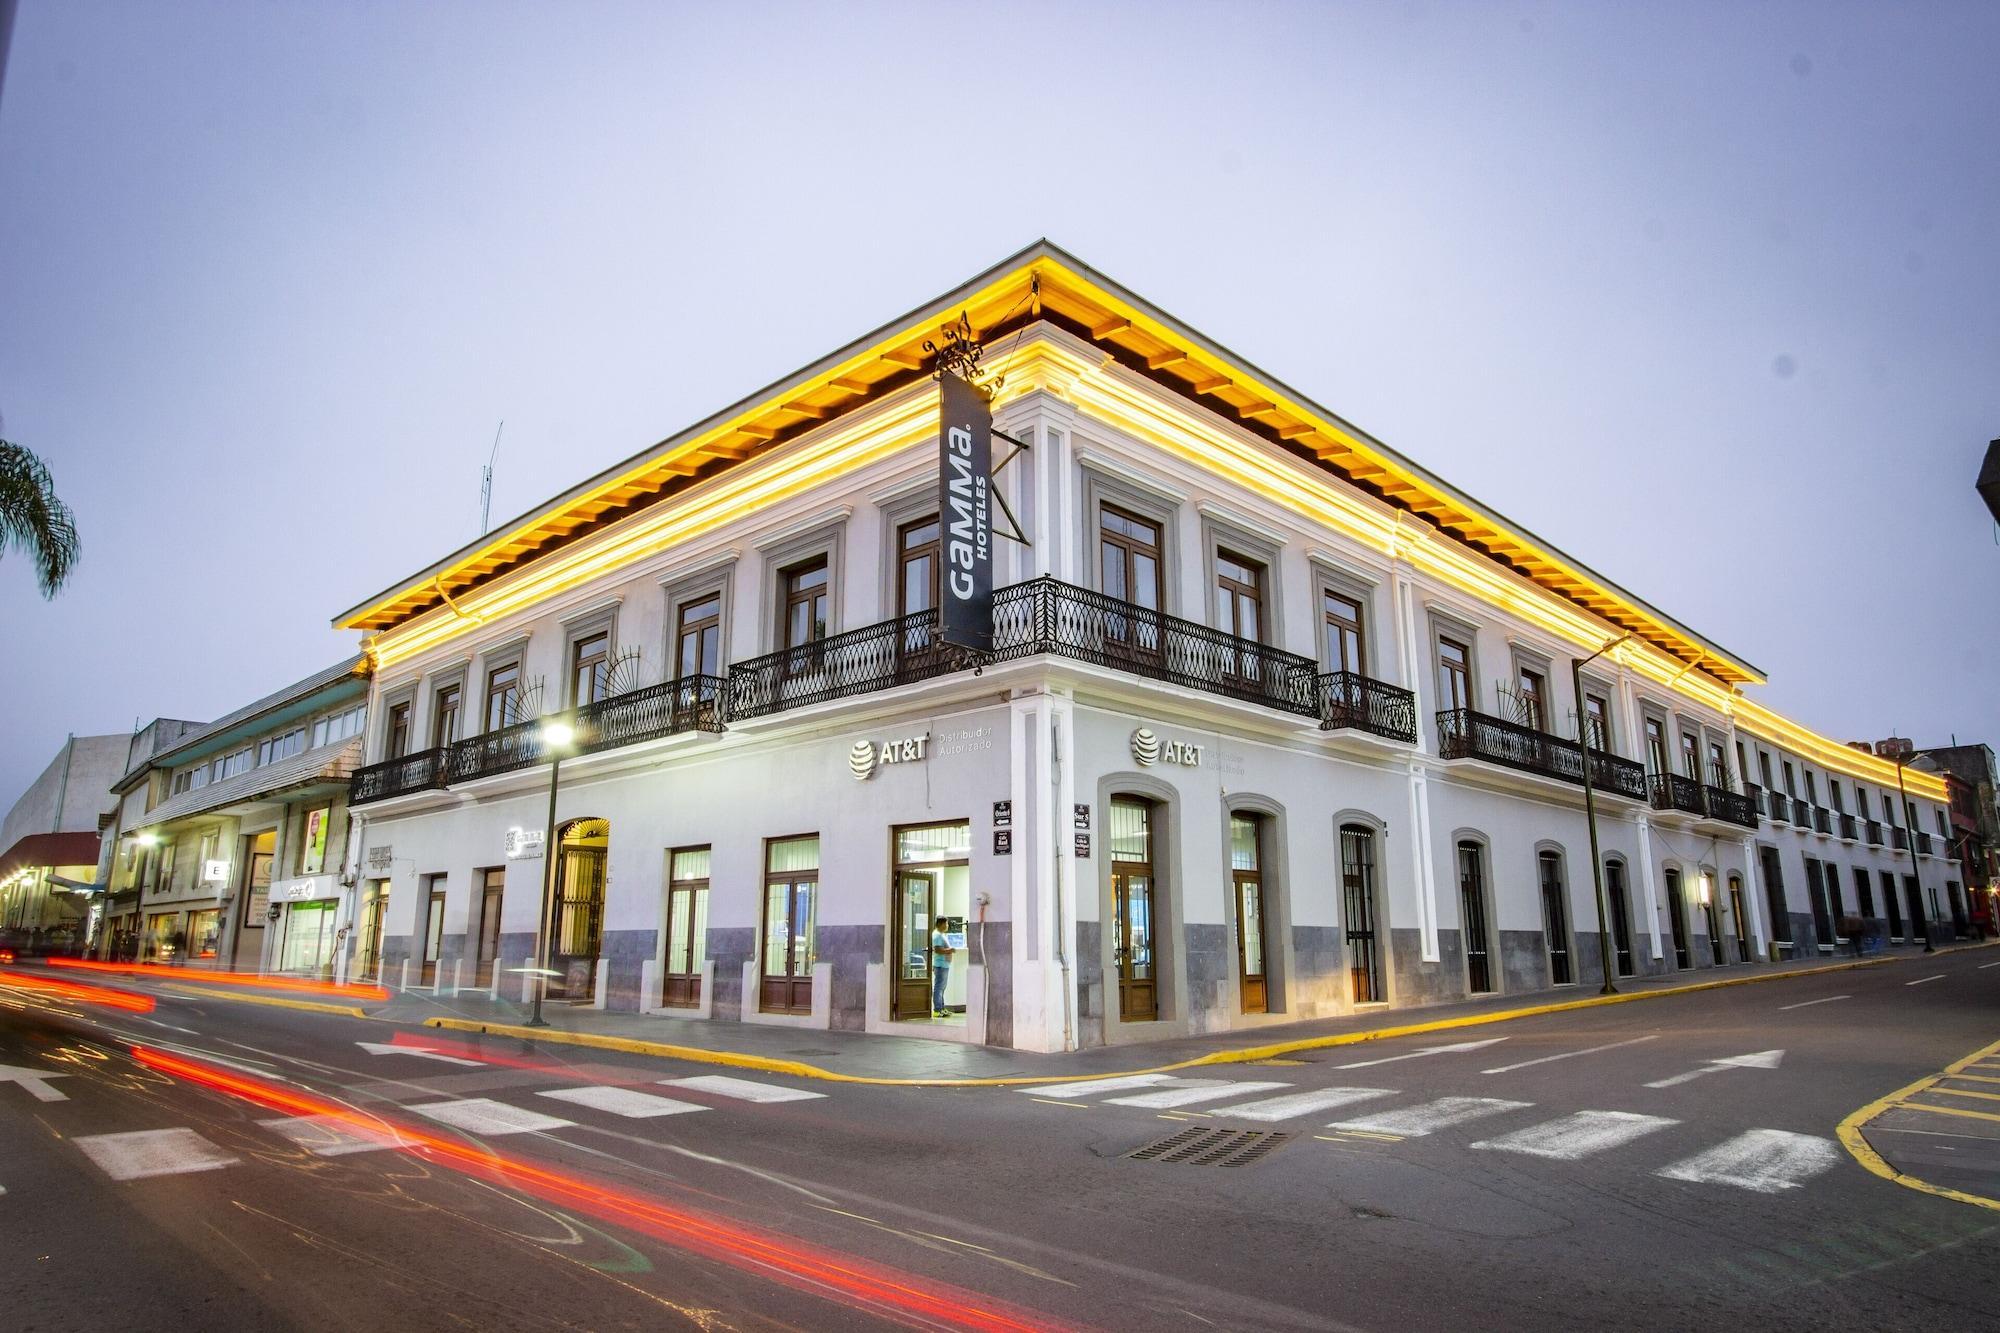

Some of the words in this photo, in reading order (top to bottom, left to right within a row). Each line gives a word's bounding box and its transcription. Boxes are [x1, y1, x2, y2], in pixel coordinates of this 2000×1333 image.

[976, 476, 987, 561] HOTELES
[939, 727, 992, 743] Distribuidor
[939, 740, 992, 756] Autorizado
[879, 735, 928, 765] AT&T
[1164, 739, 1205, 766] AT&T
